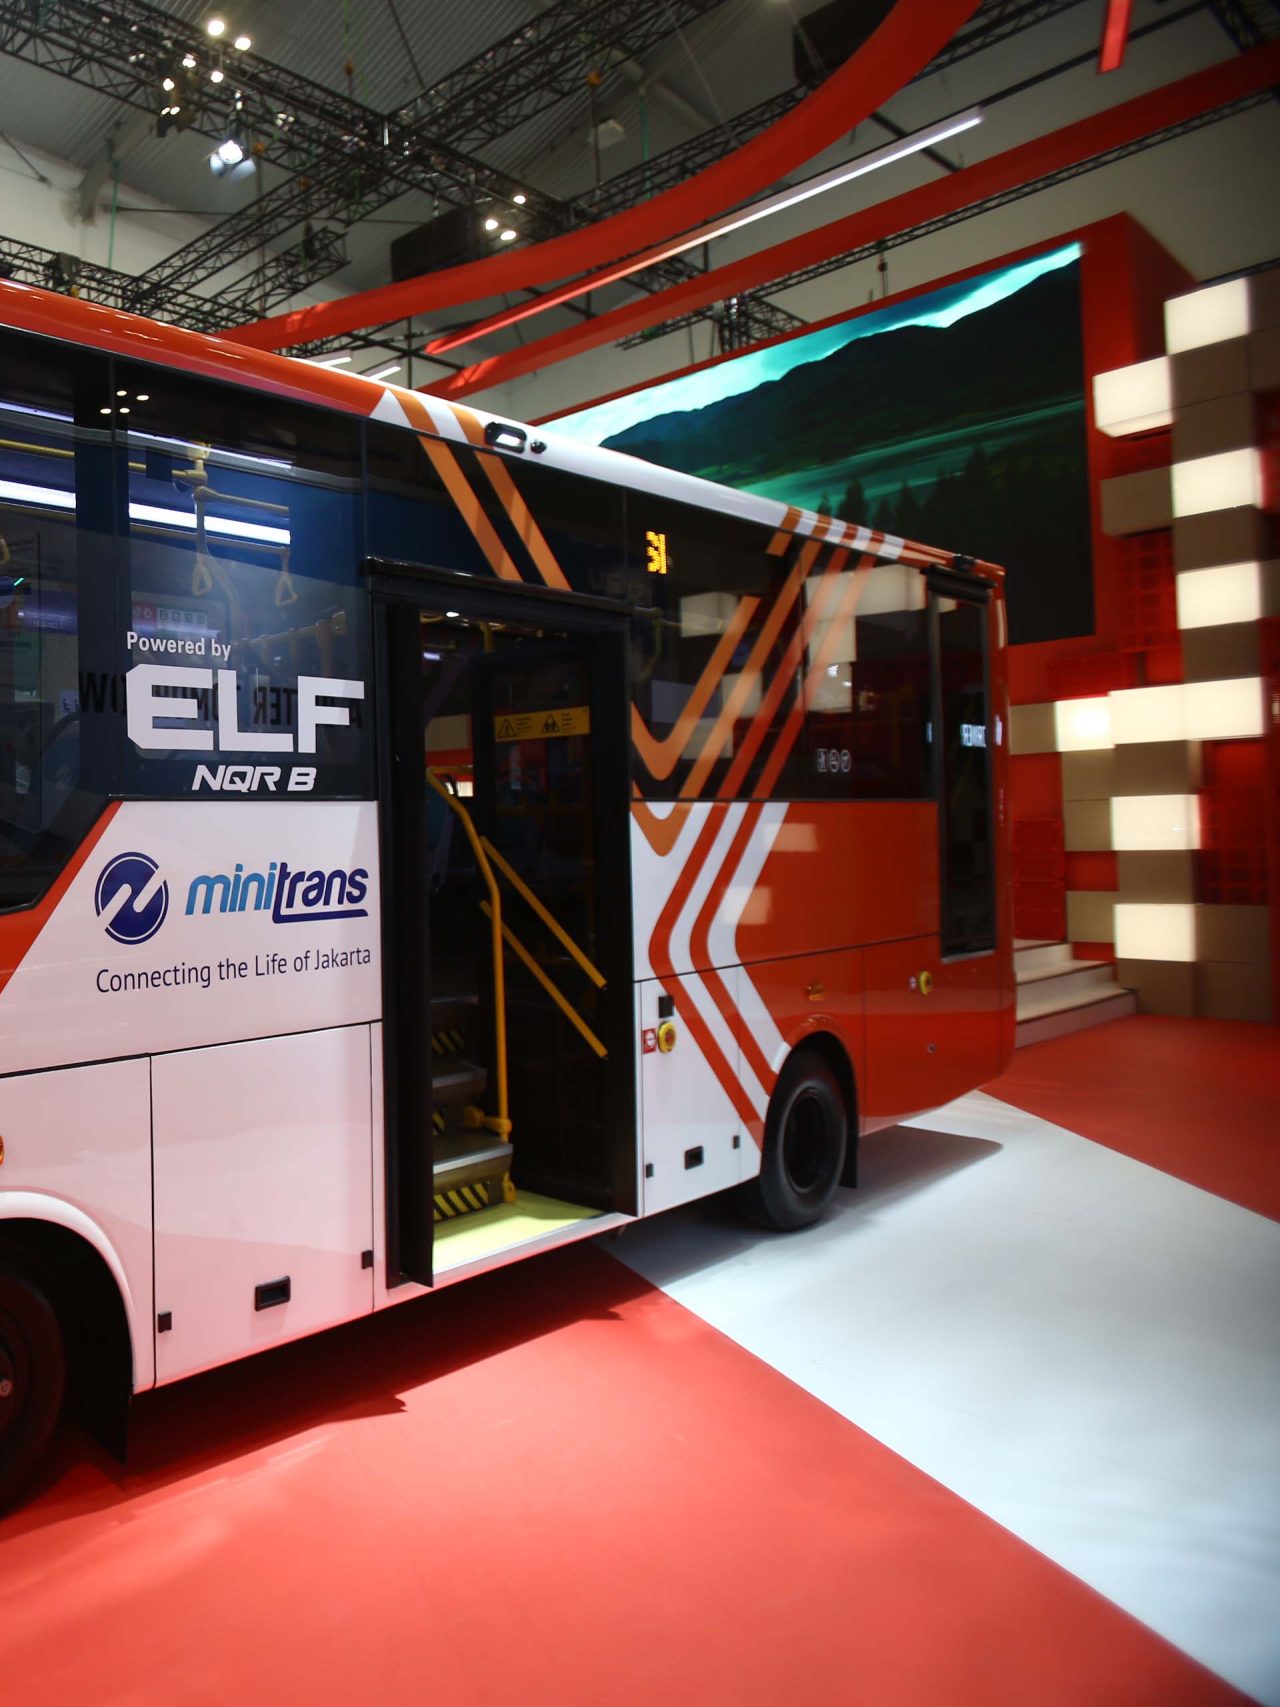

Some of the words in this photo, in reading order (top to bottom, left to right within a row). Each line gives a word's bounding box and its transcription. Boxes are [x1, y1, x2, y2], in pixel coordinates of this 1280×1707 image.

[126, 631, 206, 656] Powered
[211, 639, 231, 661] by
[126, 663, 365, 753] ELF
[191, 764, 281, 792] NQR
[287, 767, 317, 792] B
[185, 861, 369, 924] minitrans
[96, 961, 211, 993] Connecting
[218, 958, 248, 981] the
[254, 953, 288, 977] Life
[293, 951, 311, 972] of
[313, 946, 371, 970] Jakarta
